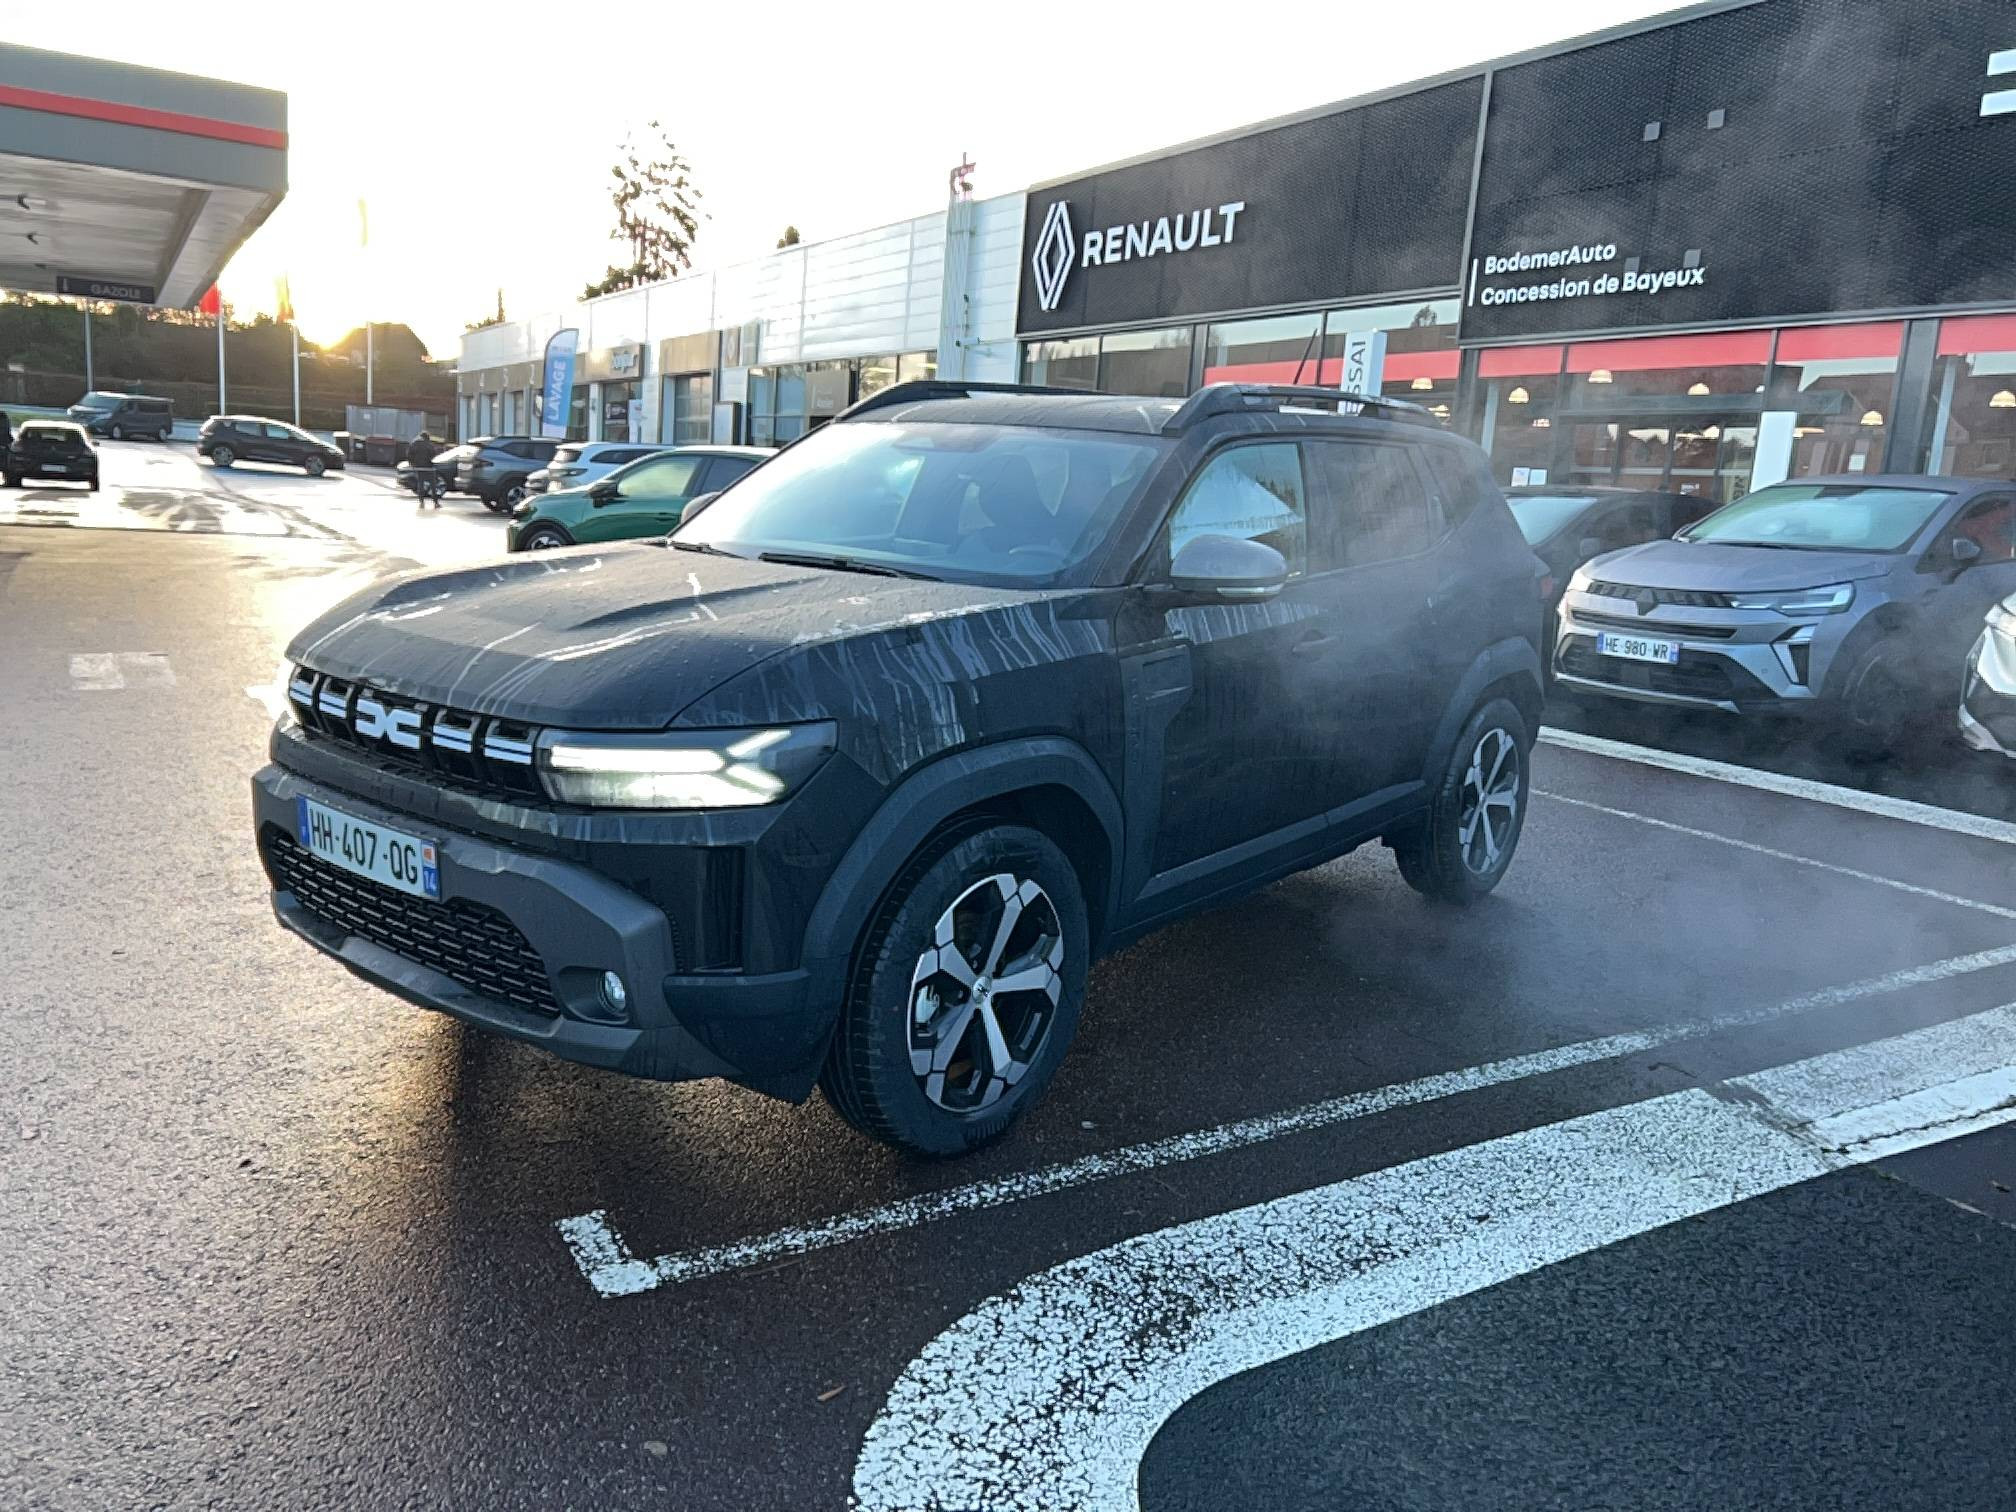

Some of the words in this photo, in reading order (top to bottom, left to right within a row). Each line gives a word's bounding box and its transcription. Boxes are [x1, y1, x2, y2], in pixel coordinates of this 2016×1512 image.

[1081, 200, 1246, 268] RENAULT
[1484, 242, 1617, 275] BodemerAuto
[1481, 277, 1589, 306] Concession
[1593, 272, 1619, 295] de
[1622, 264, 1706, 294] Bayeux
[547, 360, 567, 421] LAVAGE
